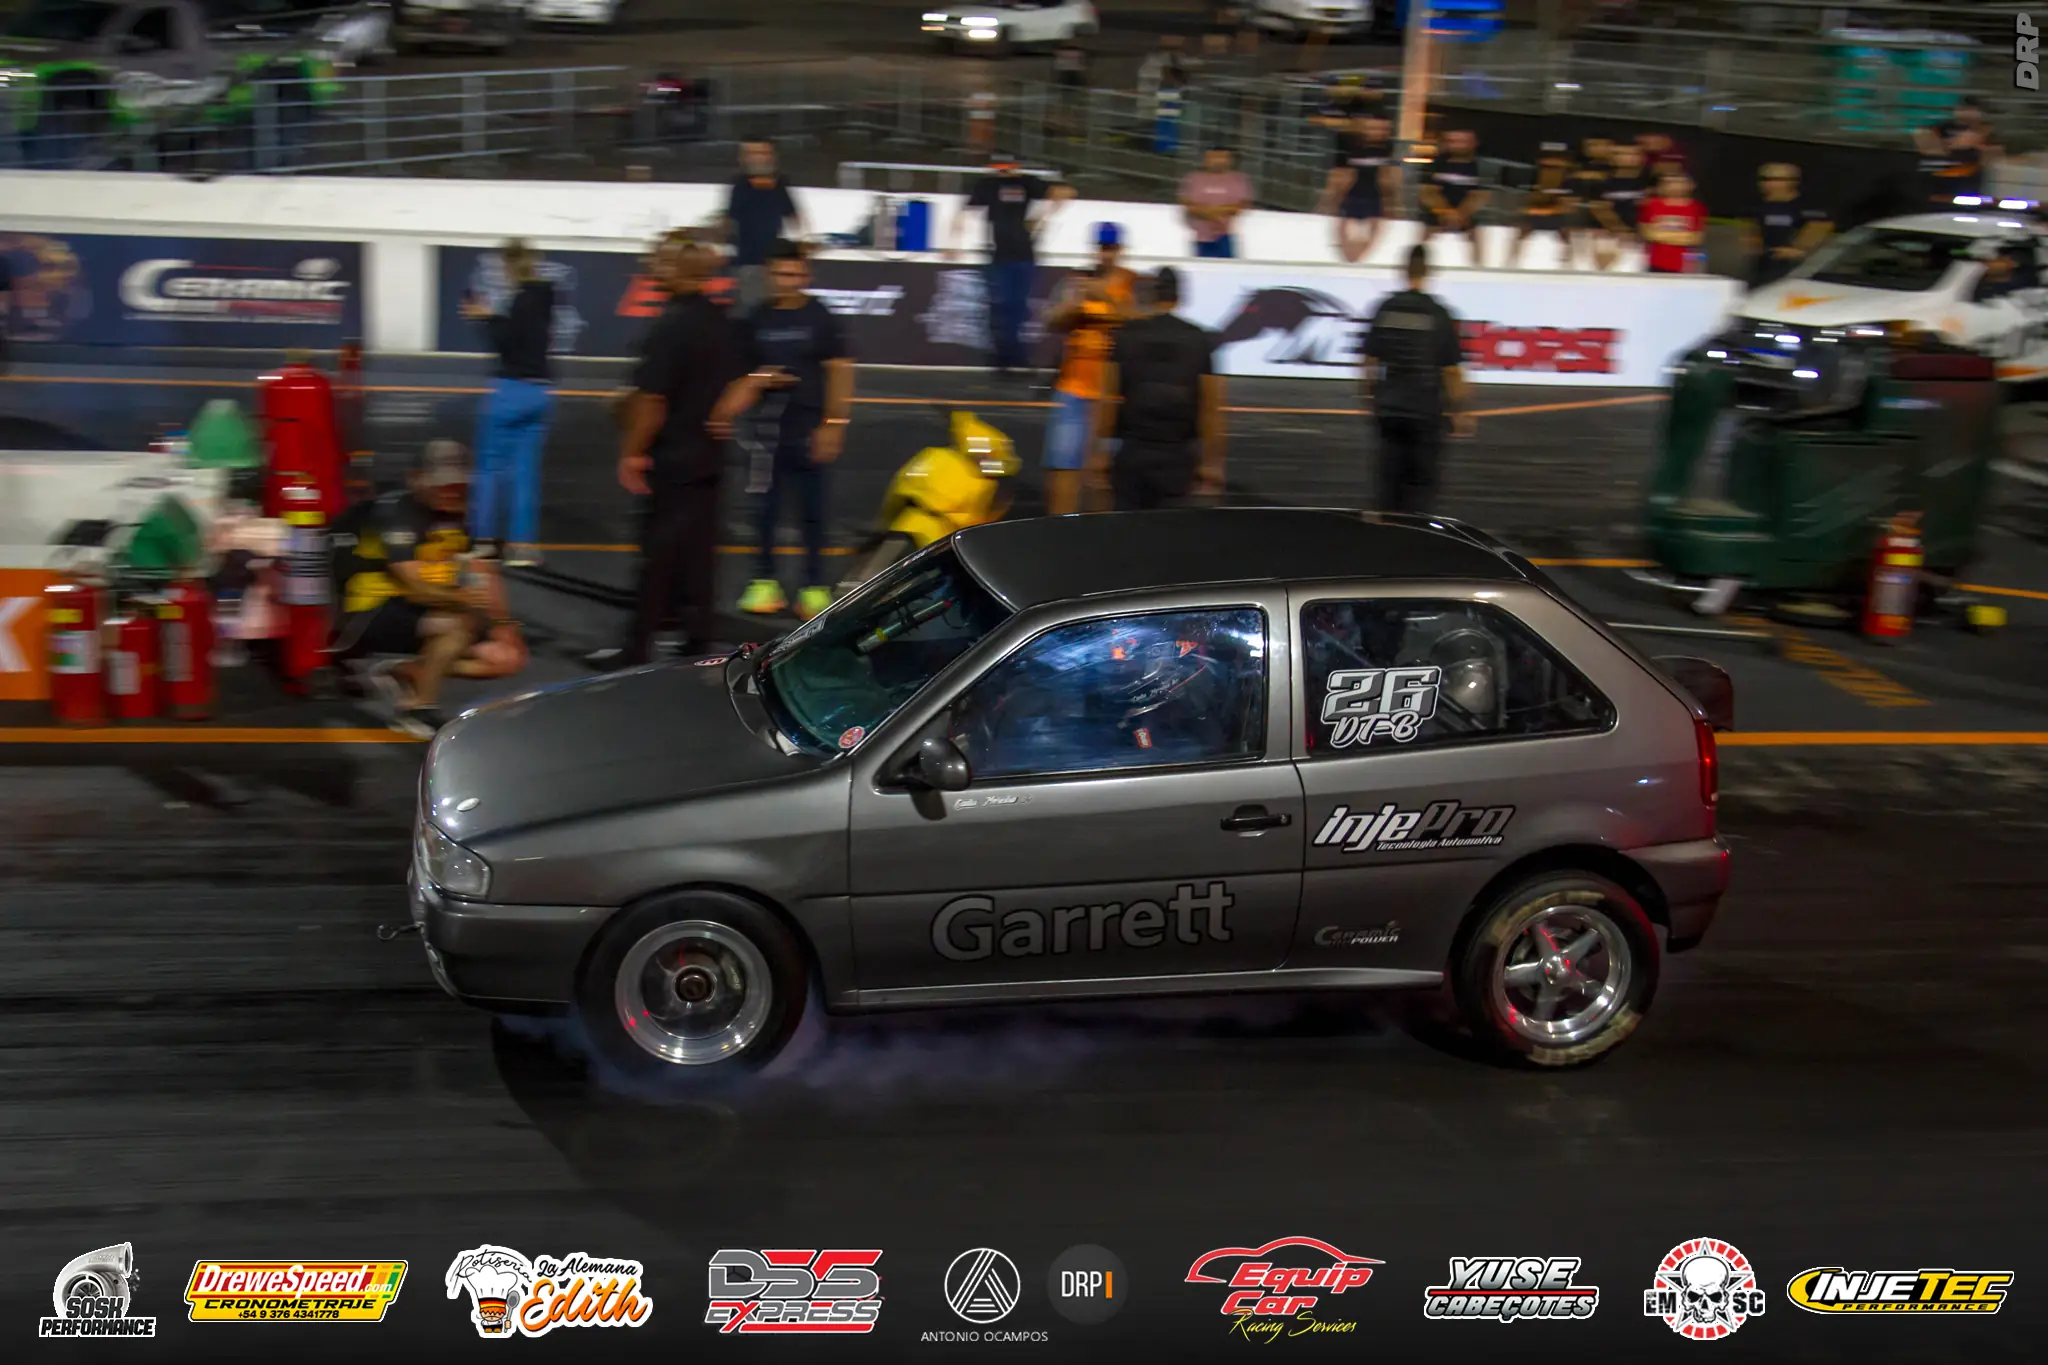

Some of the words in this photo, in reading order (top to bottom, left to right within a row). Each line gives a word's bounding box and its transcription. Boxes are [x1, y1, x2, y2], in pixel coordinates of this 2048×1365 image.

[1321, 666, 1442, 724] 26
[1330, 710, 1421, 748] DT-B
[1376, 838, 1437, 851] Tecnologia
[1437, 835, 1503, 848] Automotiva
[930, 880, 1236, 962] Garrett
[1350, 935, 1399, 945] POWER
